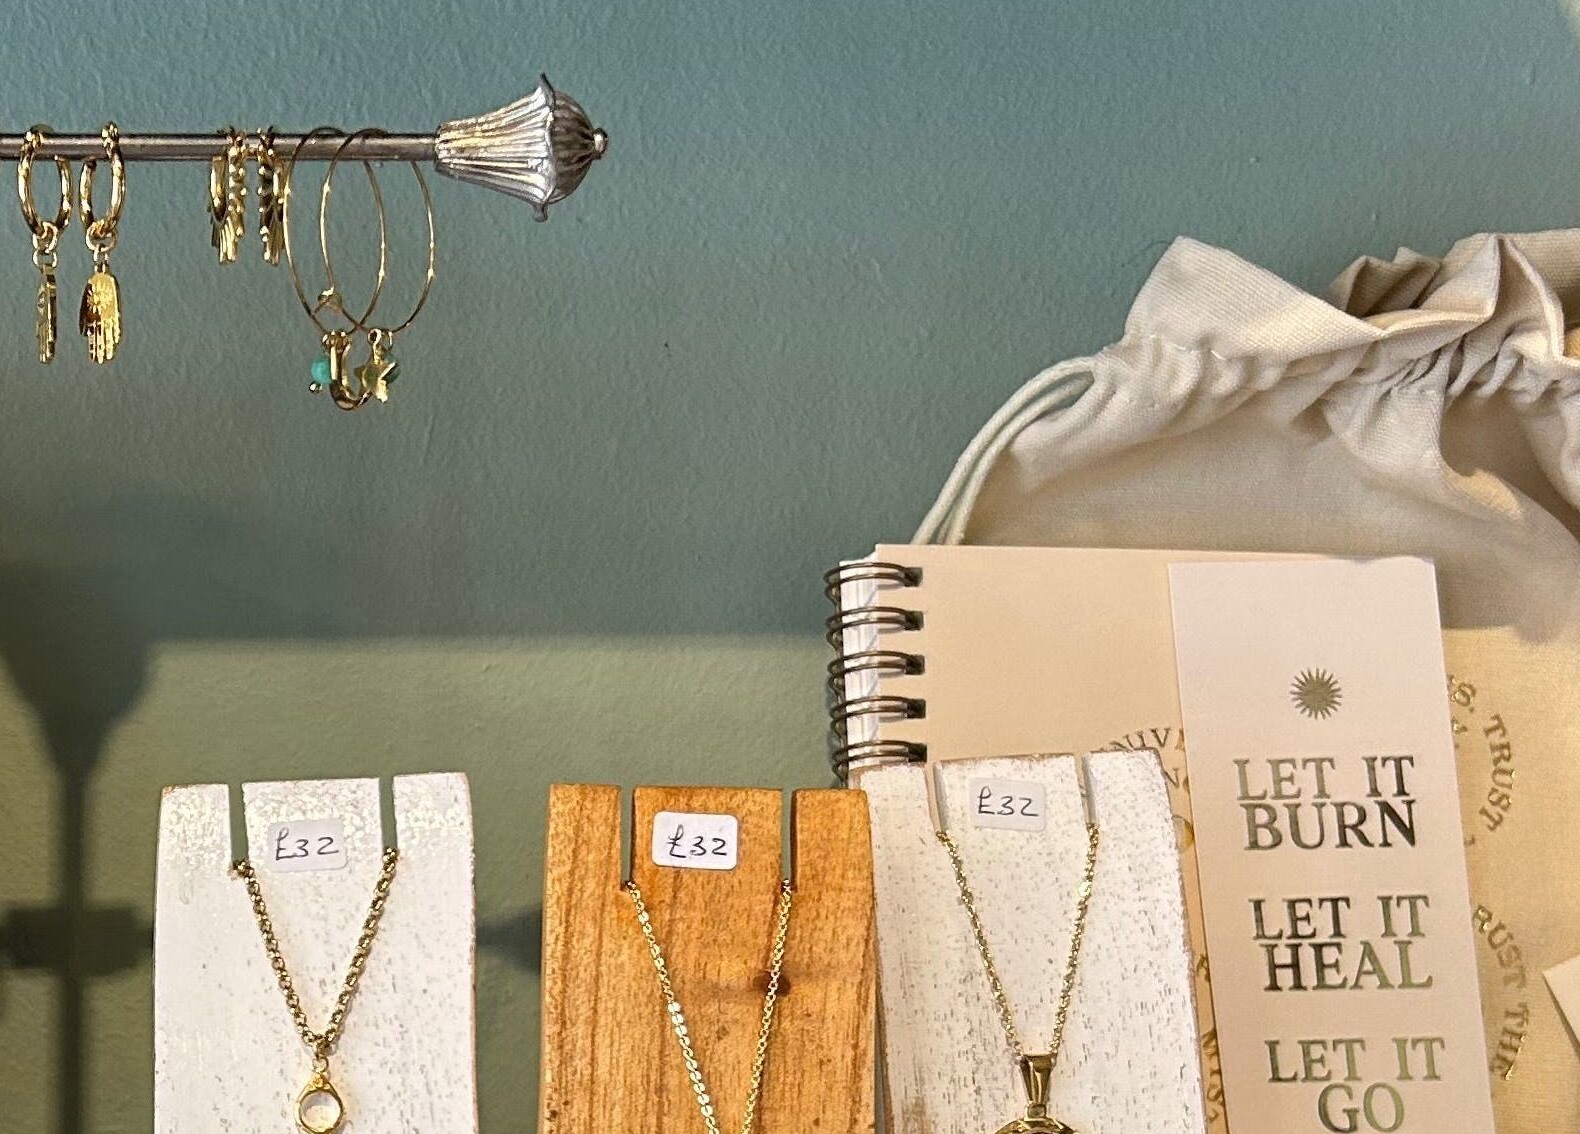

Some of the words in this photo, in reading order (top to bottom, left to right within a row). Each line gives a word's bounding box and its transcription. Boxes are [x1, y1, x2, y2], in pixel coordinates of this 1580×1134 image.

[1232, 756, 1336, 801] LET
[1361, 755, 1415, 798] IT
[1480, 713, 1516, 832] TRUST
[977, 785, 1040, 817] £32
[274, 826, 341, 861] £32
[666, 823, 729, 859] £32
[1239, 800, 1417, 851] BURN
[1247, 896, 1351, 941] LET
[1376, 894, 1430, 938] IT
[1258, 940, 1434, 992] HEAL
[1472, 904, 1527, 989] RUST
[1264, 1038, 1366, 1083] LET
[1391, 1036, 1446, 1081] IT
[1317, 1082, 1405, 1134] GO
